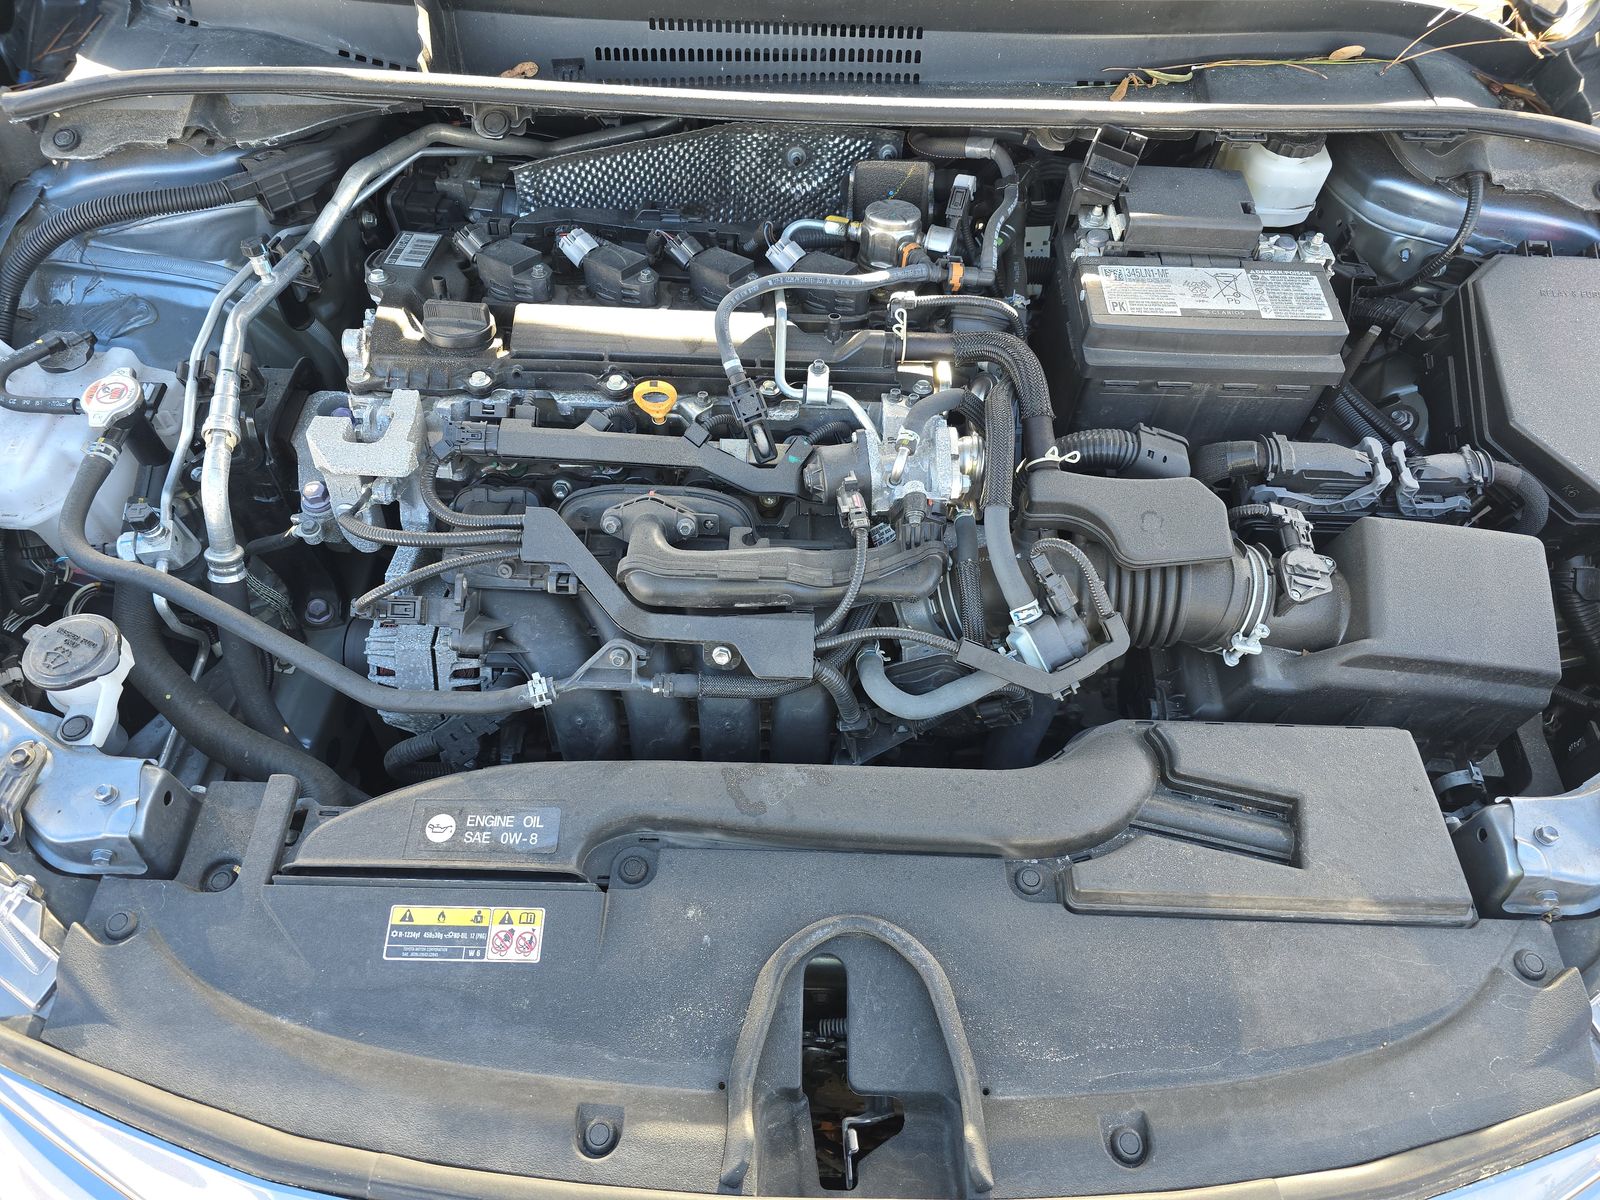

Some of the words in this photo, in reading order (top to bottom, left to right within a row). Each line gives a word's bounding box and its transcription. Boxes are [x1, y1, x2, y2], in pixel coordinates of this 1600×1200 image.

[1125, 268, 1170, 278] 345LN1-MF
[1580, 290, 1600, 299] FUS
[1111, 301, 1127, 311] PK
[1226, 297, 1241, 305] Pb
[466, 815, 514, 828] ENGINE
[523, 815, 544, 828] OIL
[463, 832, 491, 844] SAE
[500, 832, 538, 845] 0W-8
[468, 949, 475, 957] W
